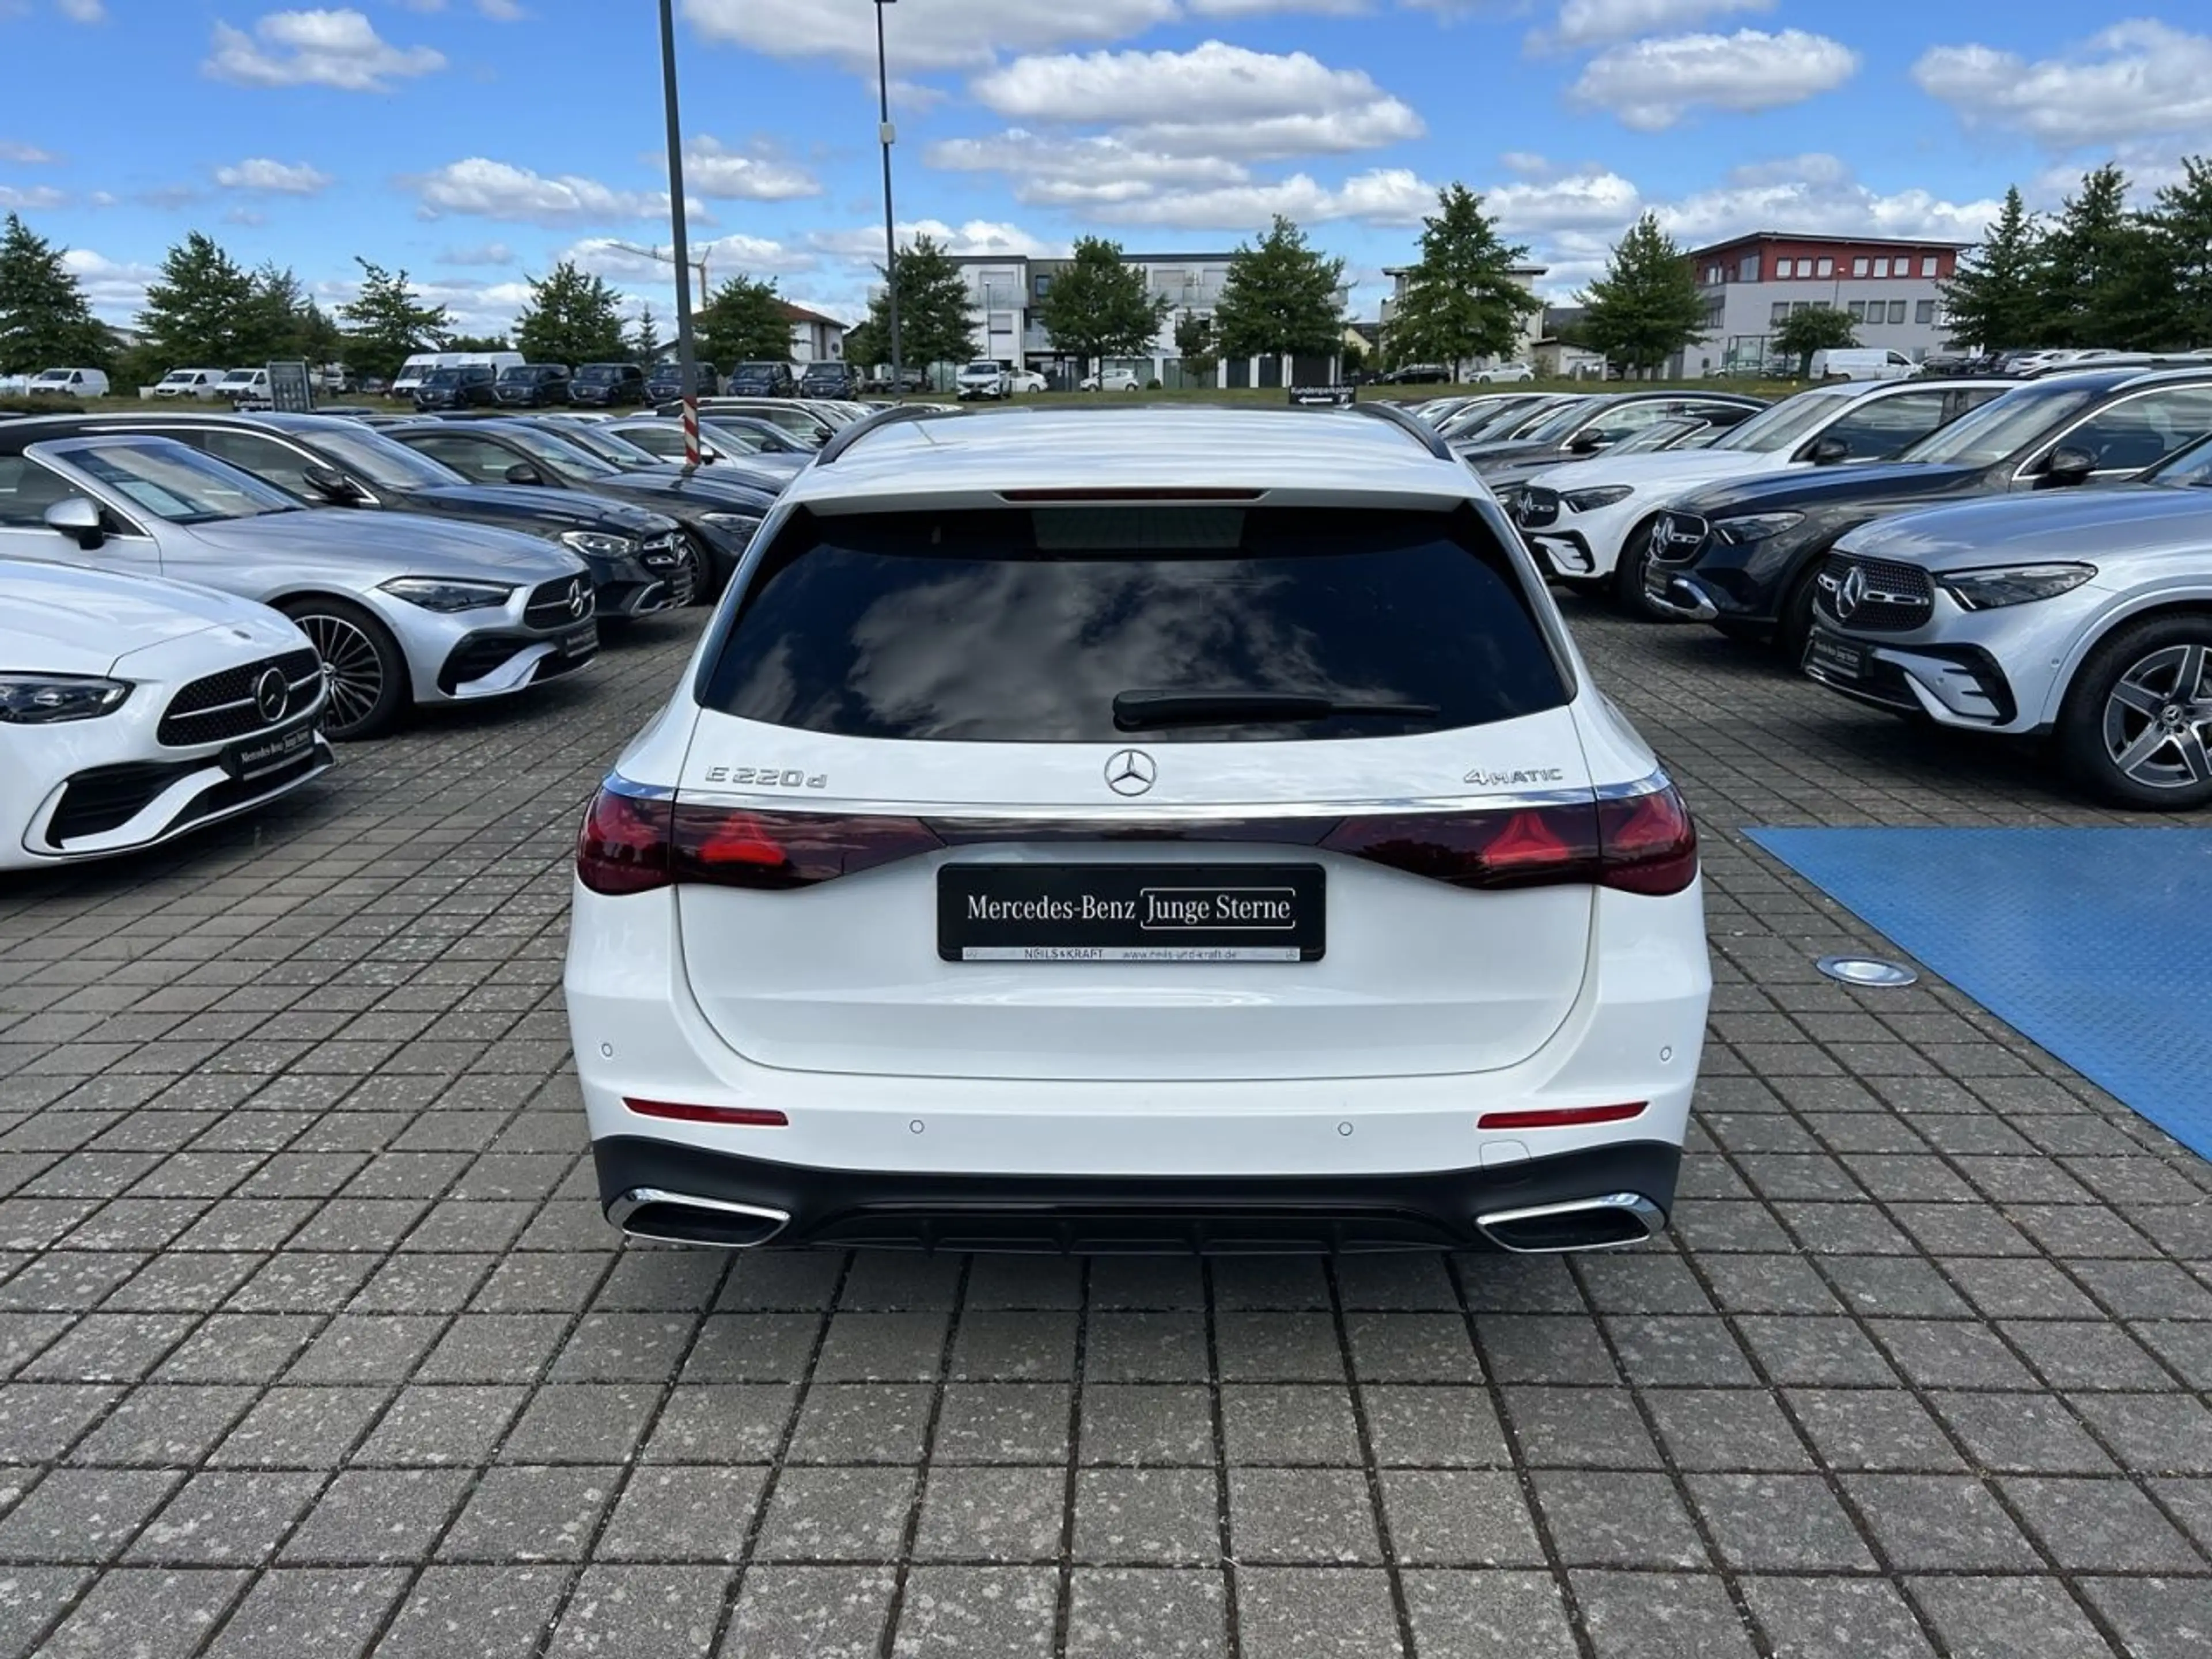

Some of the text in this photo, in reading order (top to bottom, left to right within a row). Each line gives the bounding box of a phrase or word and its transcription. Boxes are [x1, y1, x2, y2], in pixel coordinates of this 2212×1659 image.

[1464, 768, 1563, 785] 4MATIC
[968, 894, 1290, 925] Mercedes-Benz Junge Sterne
